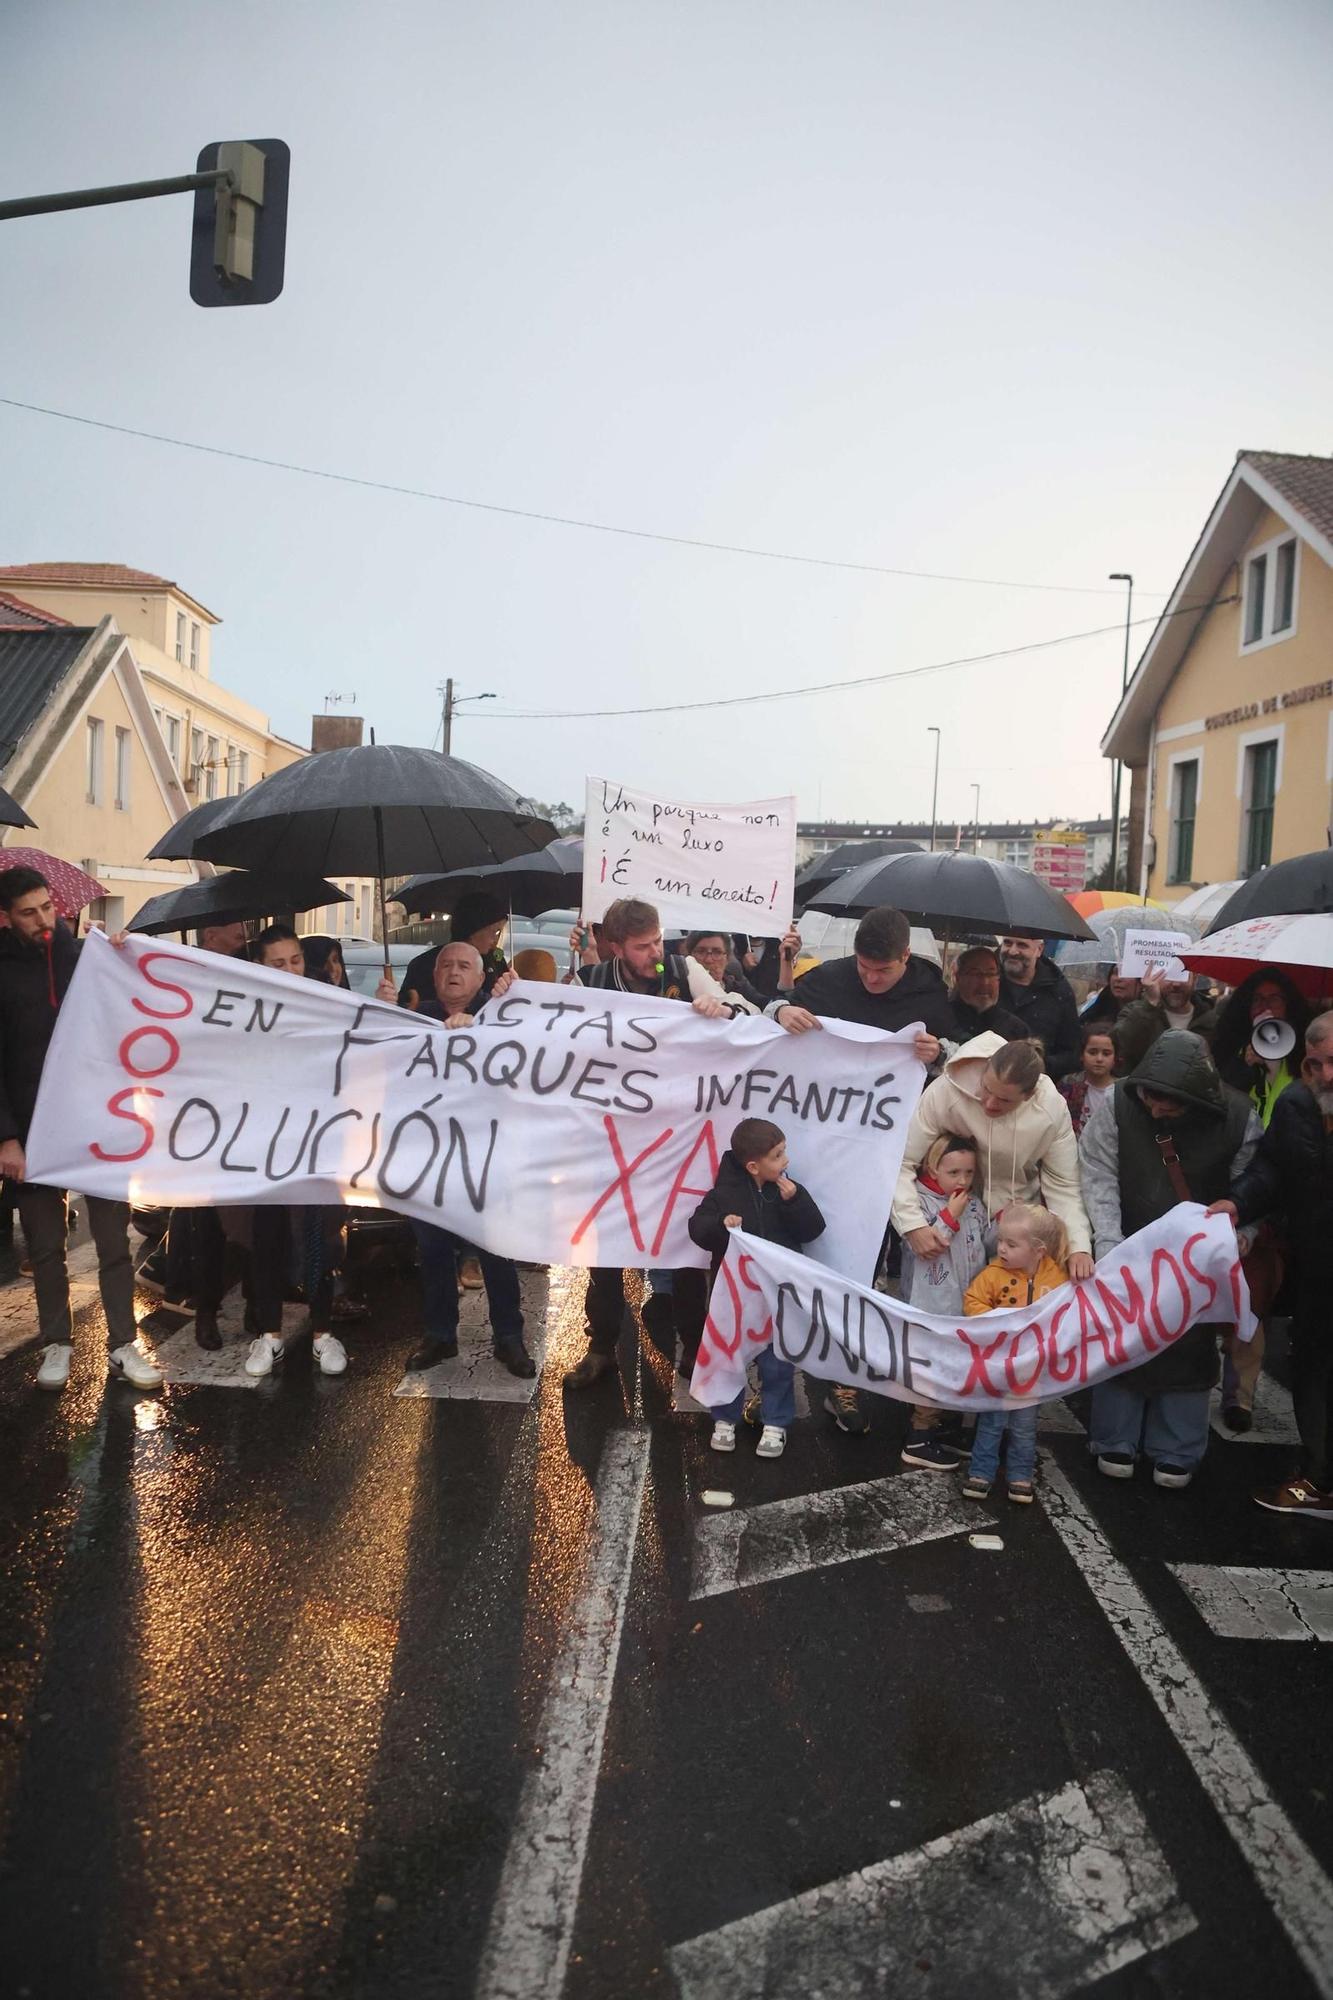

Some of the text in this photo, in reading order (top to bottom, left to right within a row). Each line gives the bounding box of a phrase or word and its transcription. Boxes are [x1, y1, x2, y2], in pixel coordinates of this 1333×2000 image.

[602, 781, 780, 827] Un parque non
[602, 819, 724, 852] é un luxo
[655, 877, 690, 897] un
[1145, 959, 1165, 967] CRO
[694, 1068, 902, 1131] INFANTÍS
[89, 1086, 499, 1213] SOLUCIÓN
